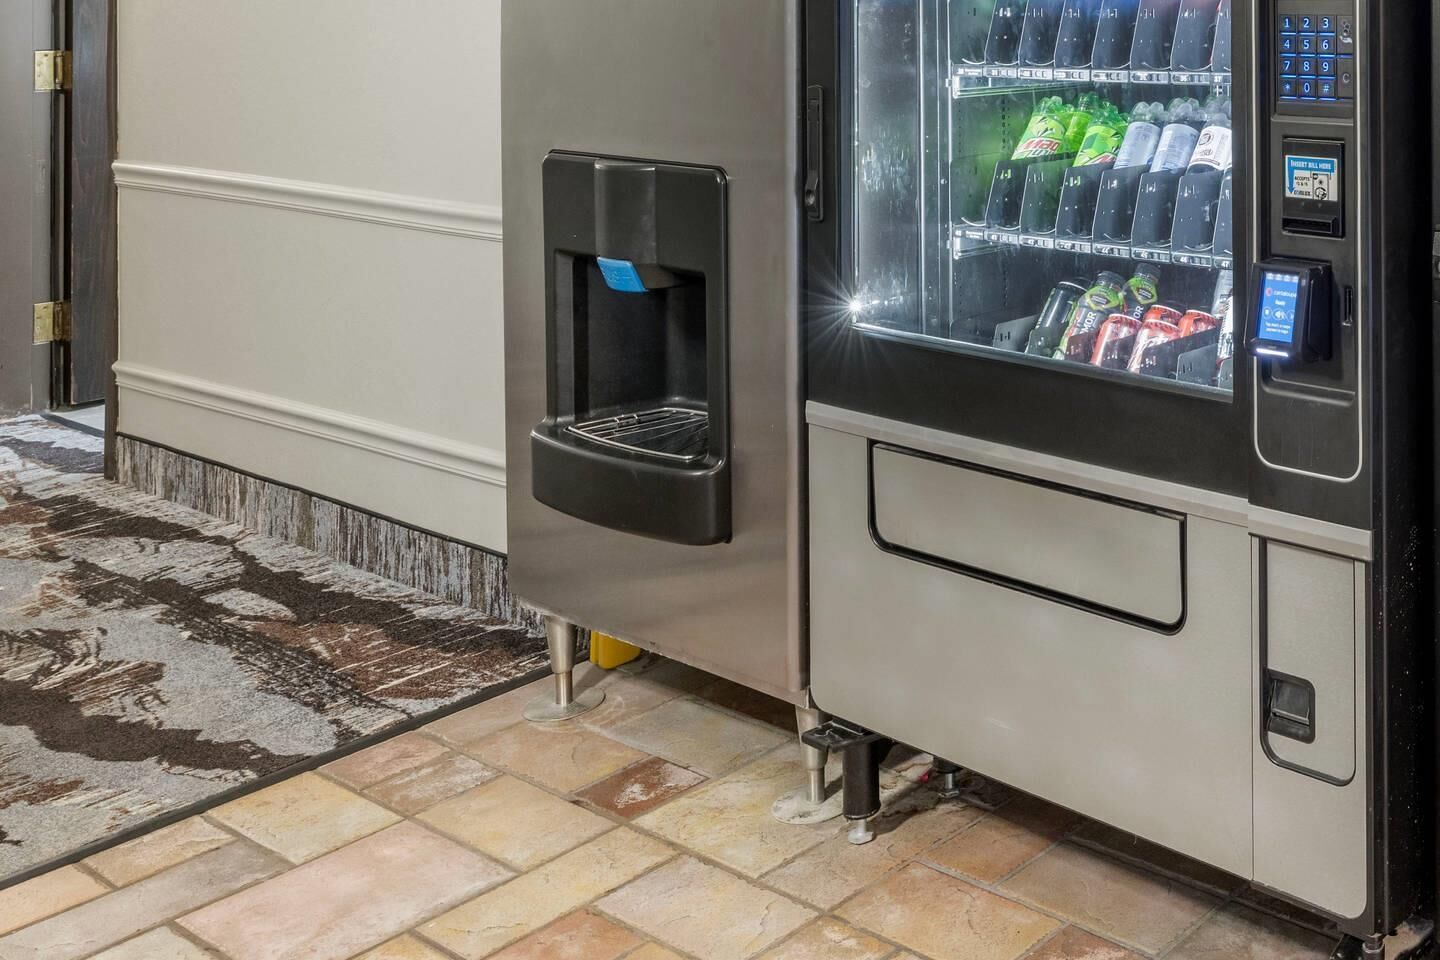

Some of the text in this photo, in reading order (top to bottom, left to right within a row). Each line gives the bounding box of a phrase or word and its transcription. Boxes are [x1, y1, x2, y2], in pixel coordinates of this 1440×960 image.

[1284, 18, 1329, 28] 1 2 3
[1284, 40, 1329, 50] 4 5 6
[1284, 61, 1329, 72] 7 8 9
[1342, 73, 1350, 83] C
[1303, 83, 1310, 93] 0
